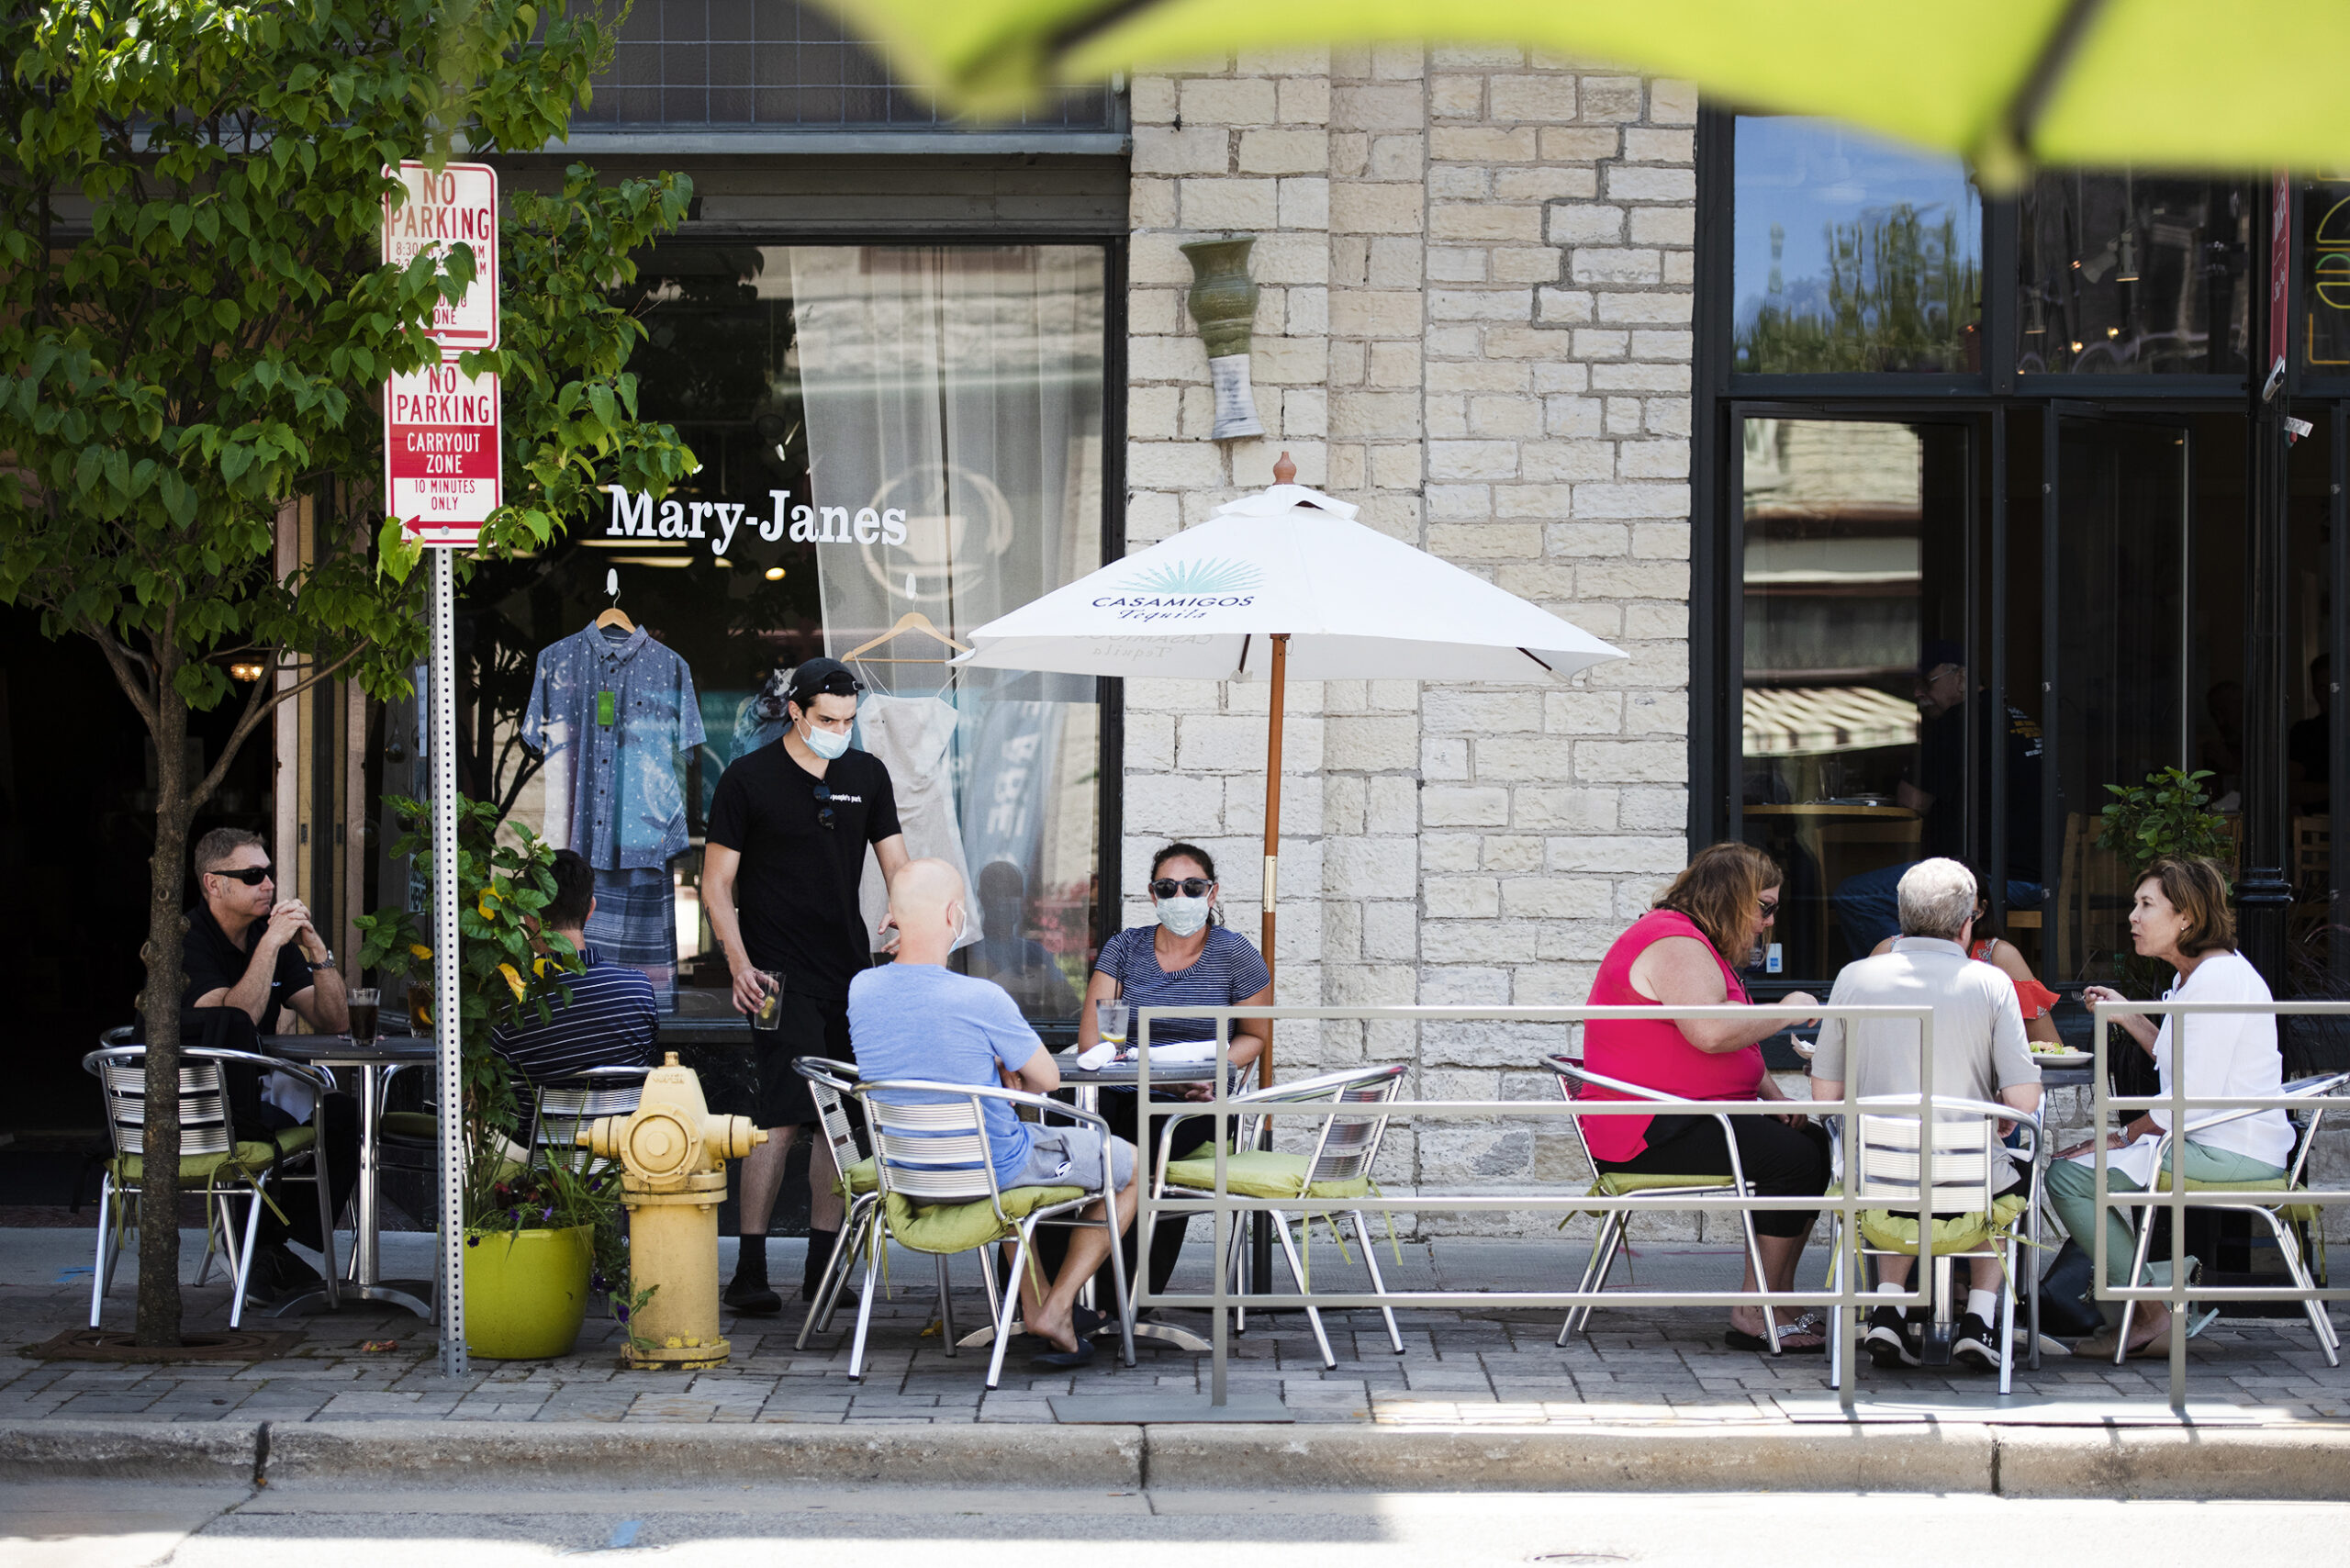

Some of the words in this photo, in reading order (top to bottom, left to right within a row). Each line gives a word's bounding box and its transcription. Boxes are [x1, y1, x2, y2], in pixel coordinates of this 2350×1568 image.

[423, 171, 456, 206] NO
[390, 206, 489, 241] PARKING
[432, 308, 457, 325] ONE
[429, 366, 456, 394] NO
[397, 395, 489, 424] PARKING
[407, 432, 480, 453] CARRYOUT
[426, 454, 463, 474] ZONE
[415, 479, 425, 494] 10
[431, 479, 476, 494] MINUTES
[431, 497, 458, 511] ONLY
[606, 484, 907, 556] Mary-Janes
[1092, 597, 1255, 608] CASAMIGOS
[1118, 609, 1207, 622] Tequila
